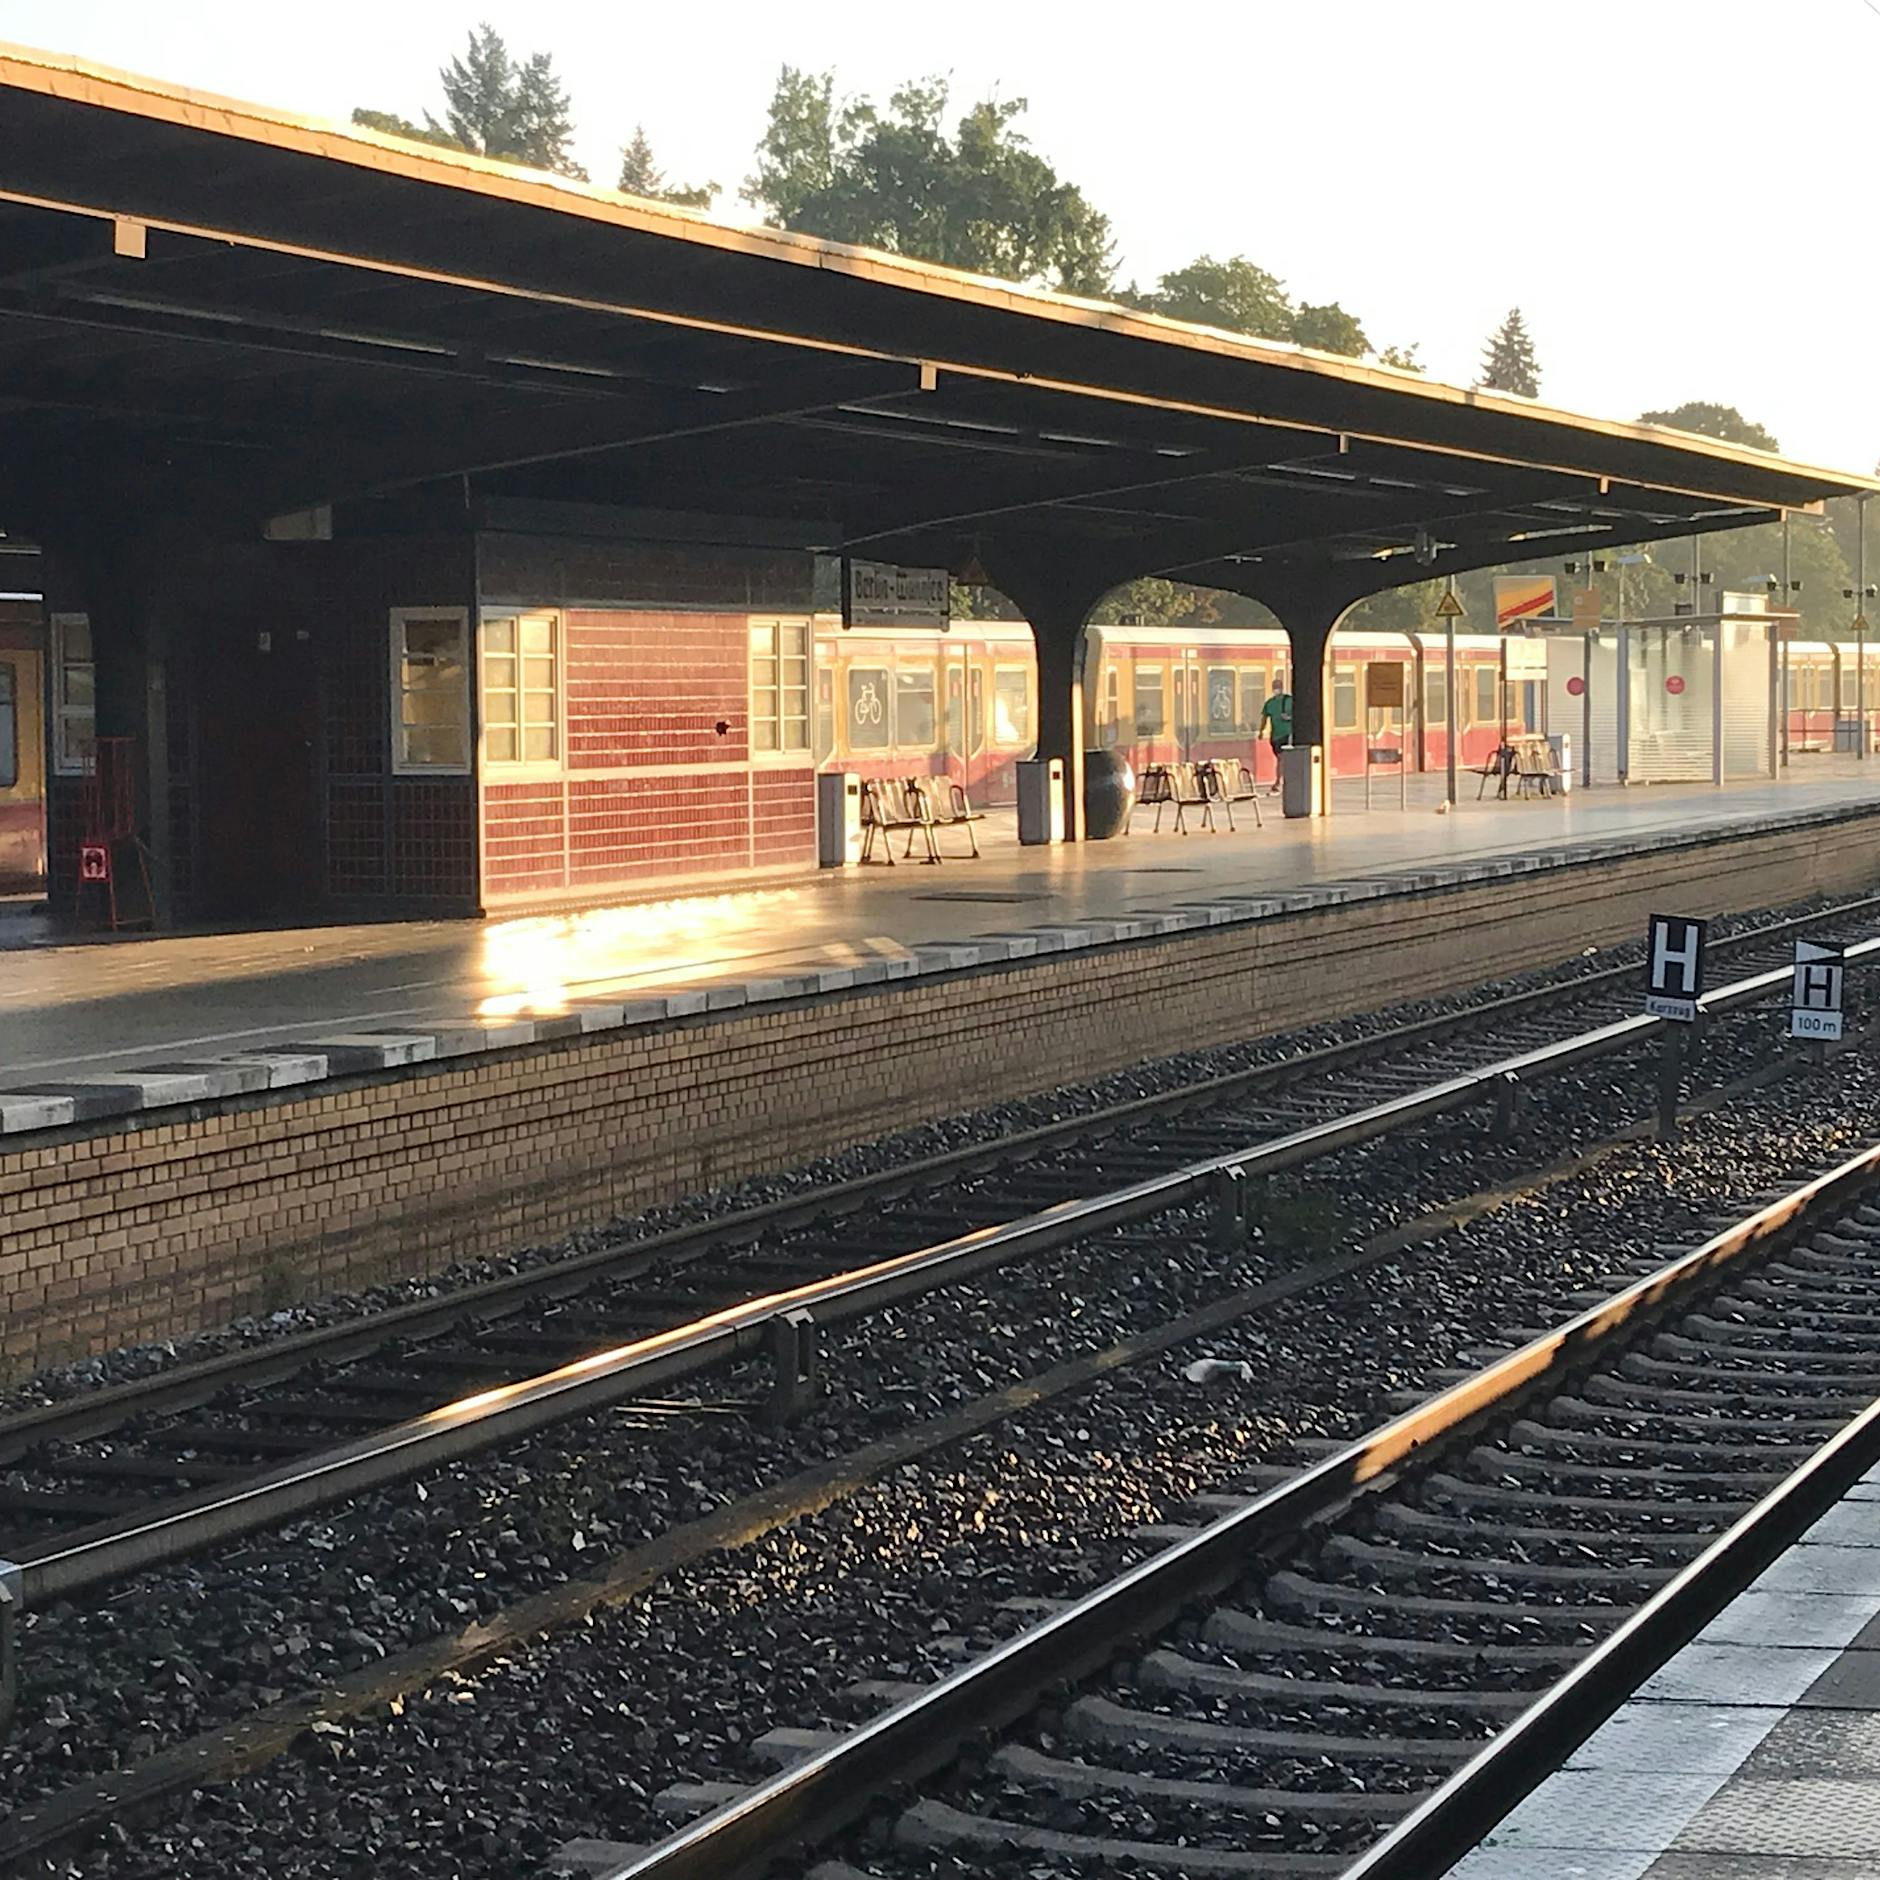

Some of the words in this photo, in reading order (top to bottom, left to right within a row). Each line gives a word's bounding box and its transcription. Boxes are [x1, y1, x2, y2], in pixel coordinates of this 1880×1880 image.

[1652, 921, 1699, 993] H
[1803, 966, 1833, 1008] H
[1798, 1016, 1821, 1032] 100
[1823, 1021, 1837, 1033] m
